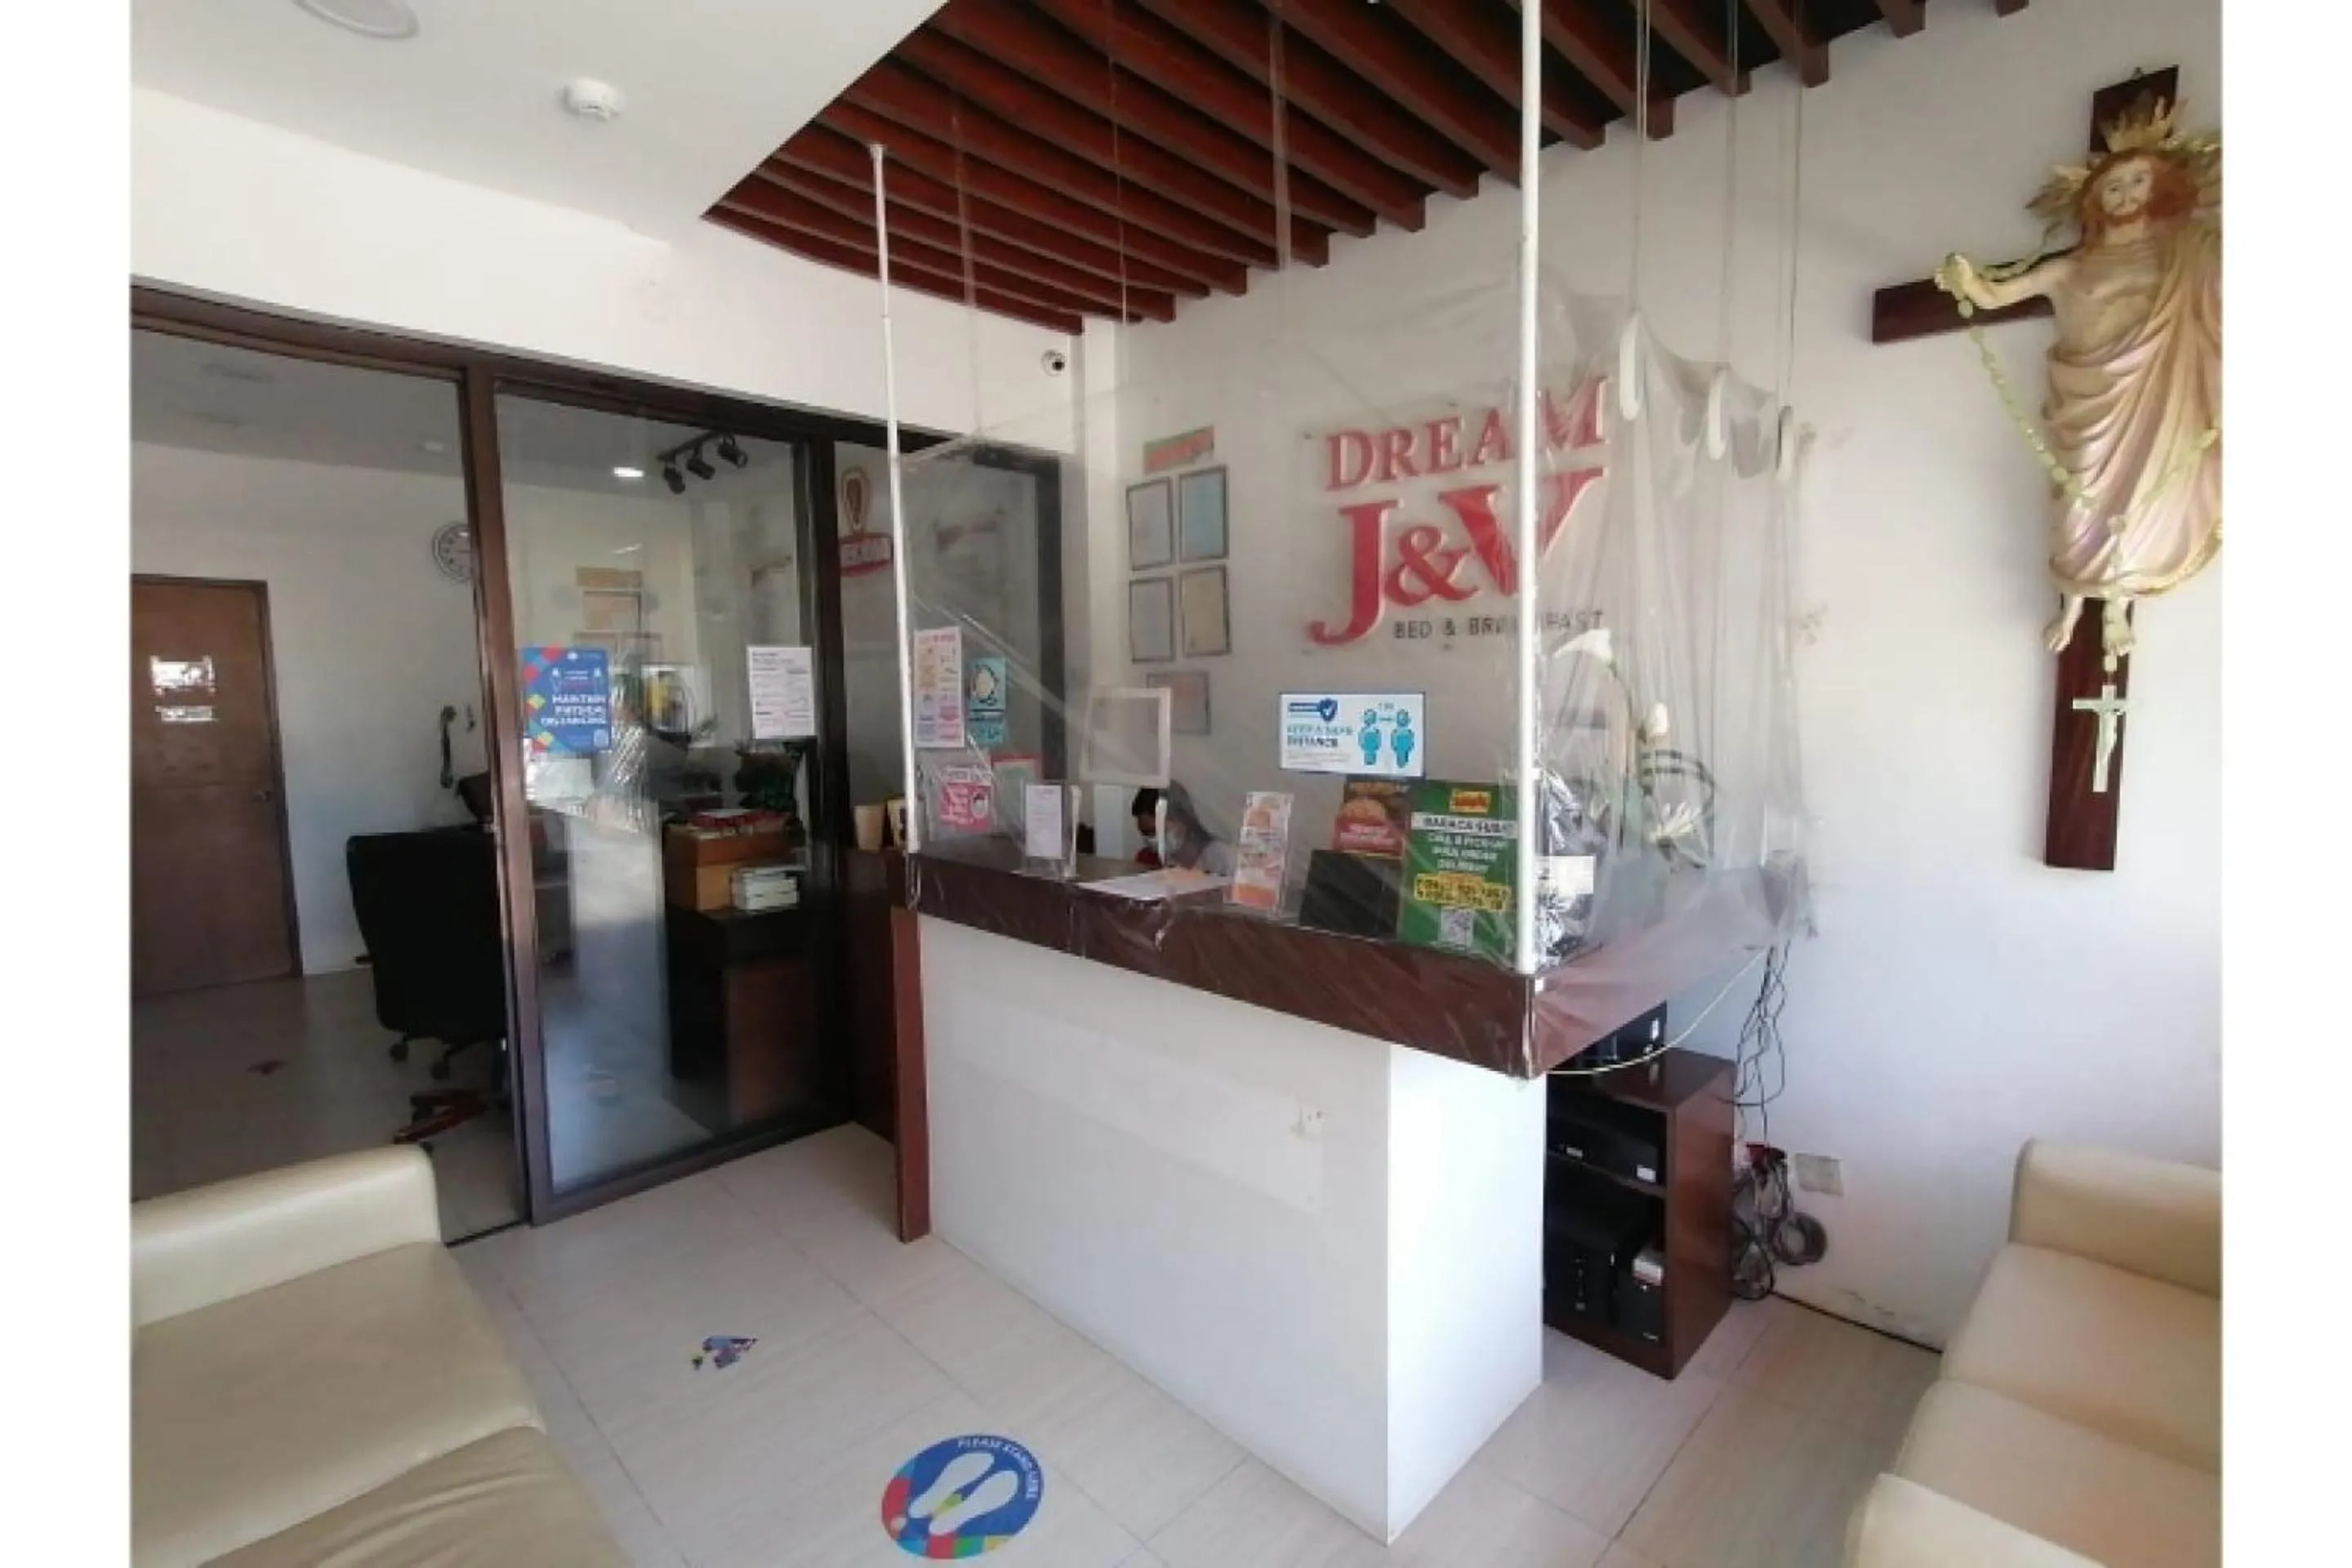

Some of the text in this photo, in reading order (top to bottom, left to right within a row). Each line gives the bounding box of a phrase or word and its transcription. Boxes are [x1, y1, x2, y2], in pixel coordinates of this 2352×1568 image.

[1325, 375, 1608, 492] DREAM
[1306, 466, 1606, 645] J&V
[1393, 619, 1432, 639] BED
[1442, 617, 1456, 636] &
[957, 1437, 1003, 1449] PLEASE
